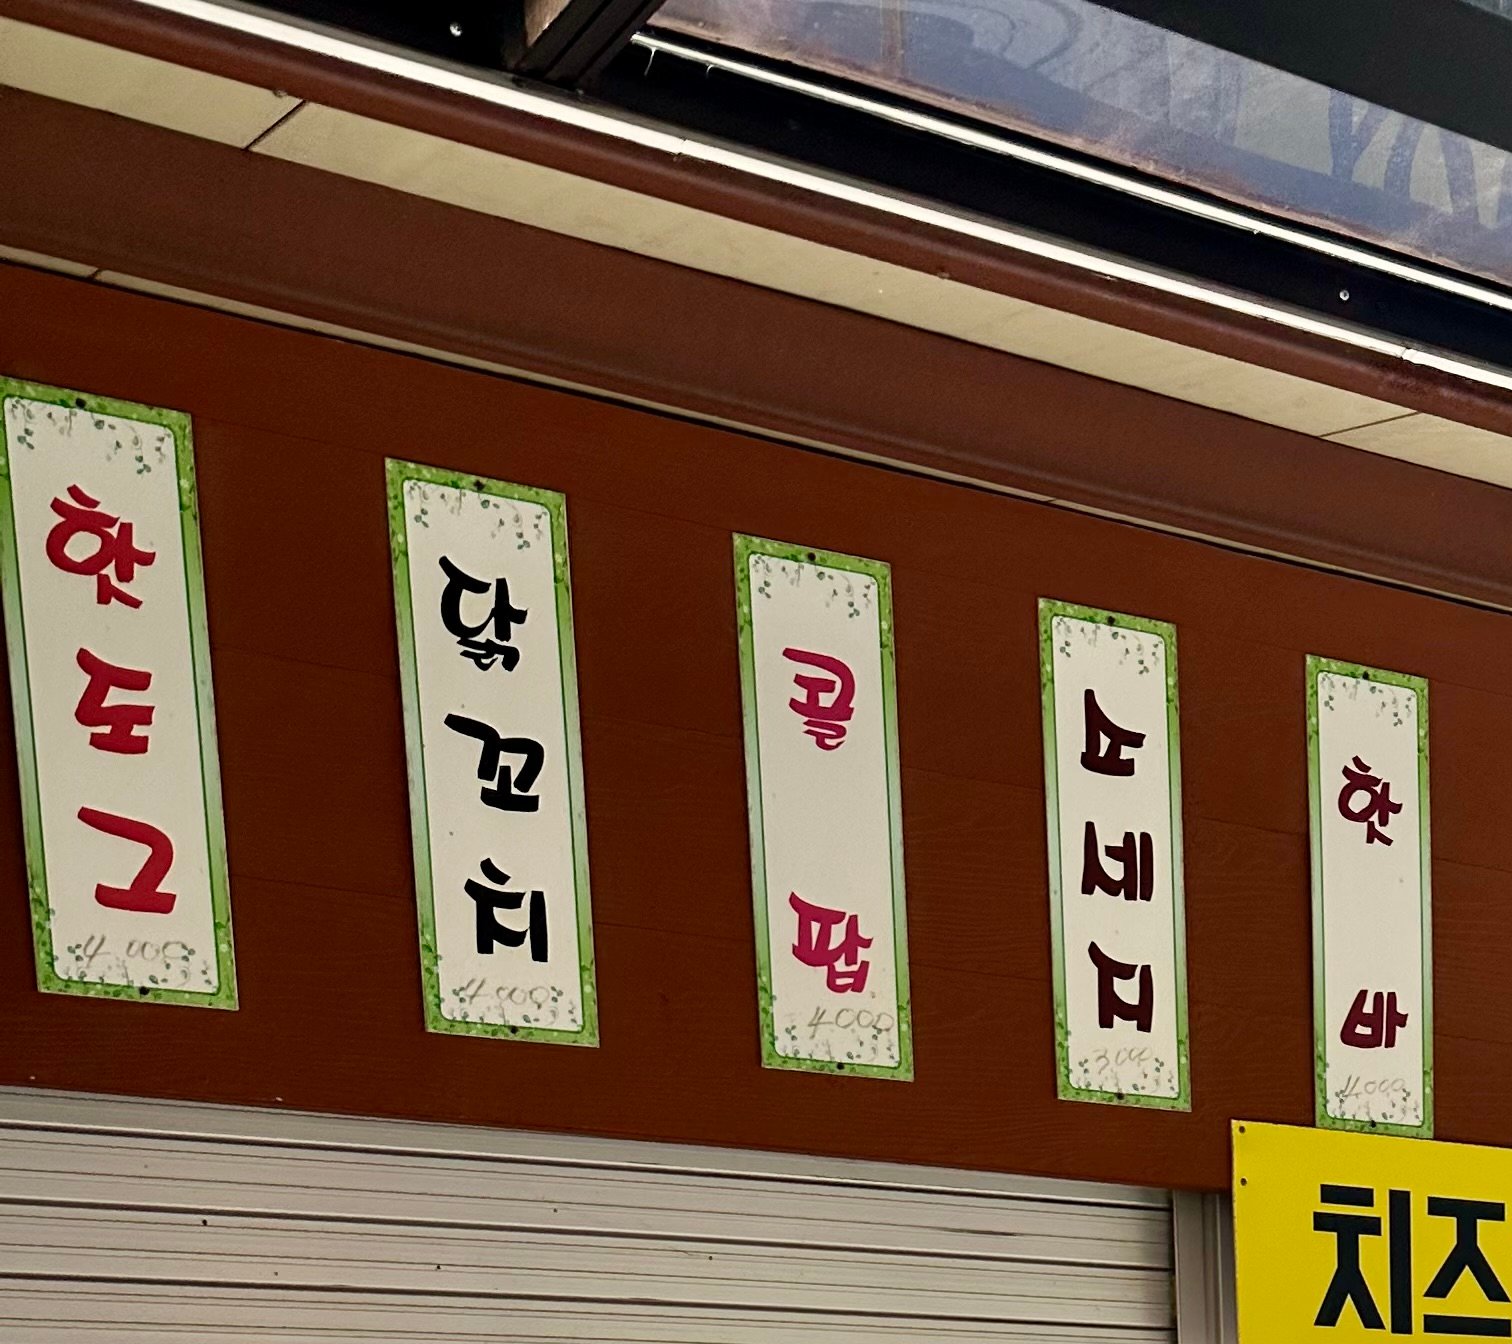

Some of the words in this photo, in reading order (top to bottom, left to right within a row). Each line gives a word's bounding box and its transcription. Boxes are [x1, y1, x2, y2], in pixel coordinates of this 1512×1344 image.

[46, 484, 177, 915] 핫도그
[438, 555, 549, 963] 닭꼬치
[782, 647, 873, 994] 콜팝
[1080, 688, 1154, 1033] 소세지
[1337, 755, 1409, 1049] 핫바
